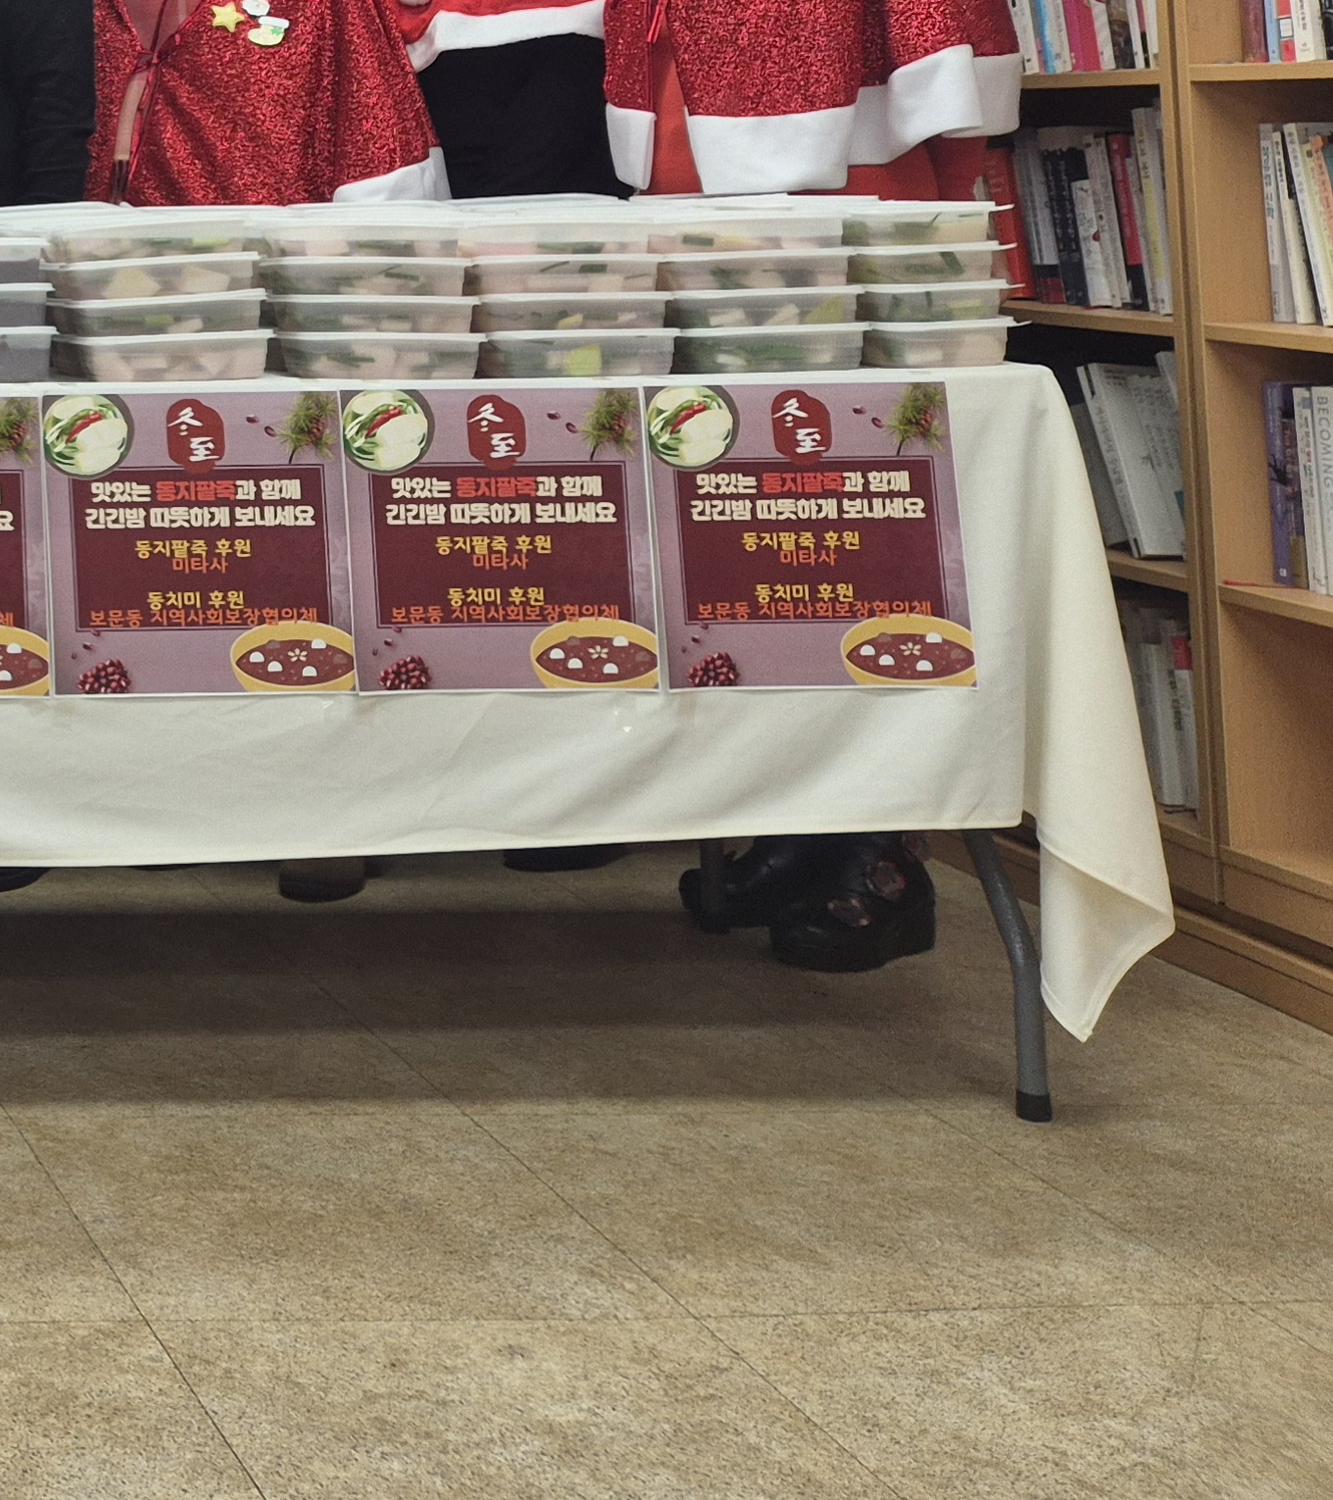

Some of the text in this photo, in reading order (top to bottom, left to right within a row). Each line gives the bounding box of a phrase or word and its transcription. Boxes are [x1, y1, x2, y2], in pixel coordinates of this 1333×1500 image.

[1317, 395, 1333, 489] BECOMING
[91, 479, 302, 502] 맛있는 함께
[392, 475, 603, 498] 맛있는 함께
[696, 471, 911, 494] 맛있는 함께
[84, 506, 315, 529] 긴긴밤 따뜻하게 보내세요
[385, 503, 616, 525] 긴긴밤 따뜻하게 보내세요
[690, 498, 925, 521] 긴긴밤 따뜻하게 보내세요
[215, 539, 252, 558] 후원
[516, 536, 553, 555] 후원
[823, 531, 861, 550] 후원
[146, 591, 245, 610] 동치미 후원
[448, 587, 546, 607] 동치미 후원
[754, 583, 855, 603] 동치미 후원
